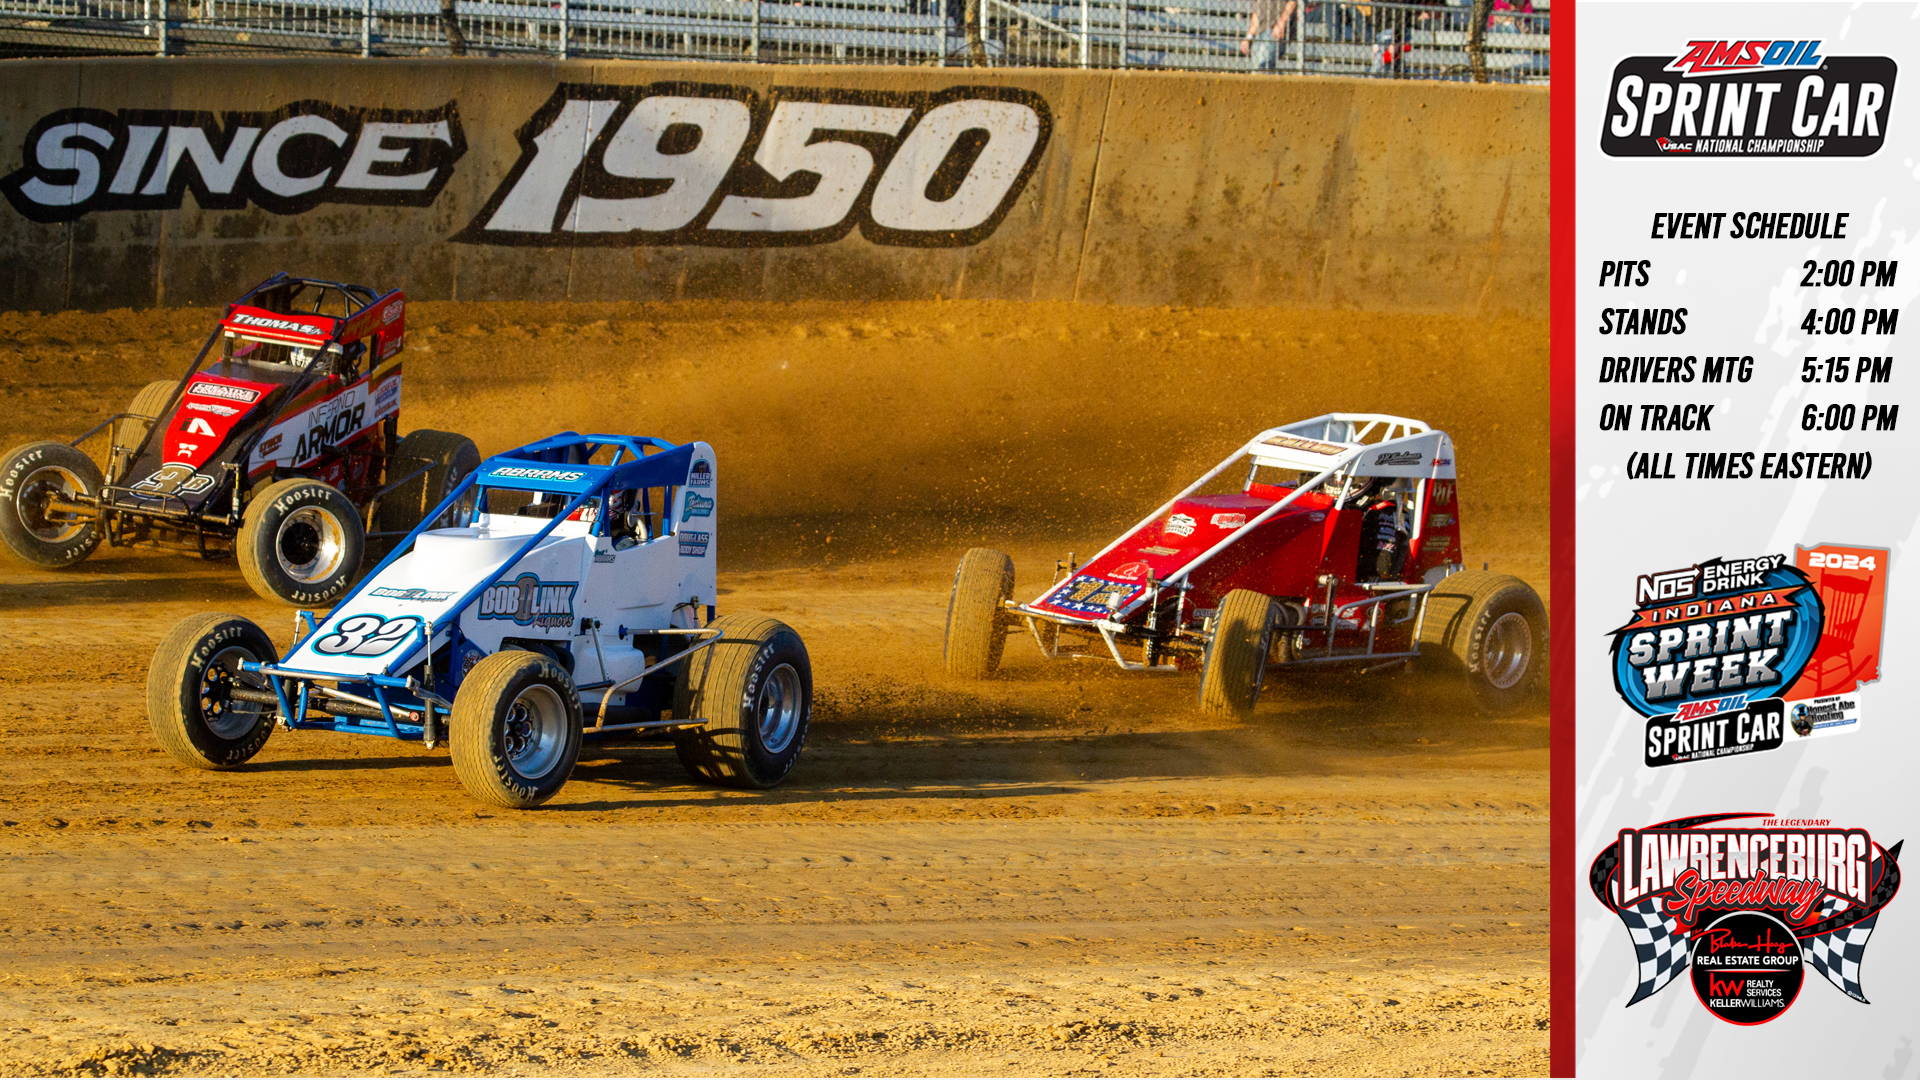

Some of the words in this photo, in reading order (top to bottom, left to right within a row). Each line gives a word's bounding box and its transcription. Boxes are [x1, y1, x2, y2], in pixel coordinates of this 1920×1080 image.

[19, 114, 453, 206] SINCE
[484, 96, 1040, 234] 1950
[232, 313, 313, 332] THOMAS
[291, 402, 365, 467] ARMOR
[0, 449, 42, 501] Hoosier
[491, 467, 585, 481] ABRAMS
[690, 472, 711, 480] MILLER
[273, 485, 332, 516] Hoosier
[679, 533, 709, 543] DOUGLASS
[679, 544, 691, 554] BODY
[691, 544, 706, 554] SHOP
[291, 574, 347, 603] Hoosier
[318, 616, 418, 656] 32
[532, 609, 574, 633] Liquors
[1469, 609, 1491, 673] Hoosier
[190, 626, 242, 673] Hoosier
[538, 660, 581, 710] Hoosier
[743, 643, 775, 712] Hoosier
[494, 755, 539, 800] Hoosier
